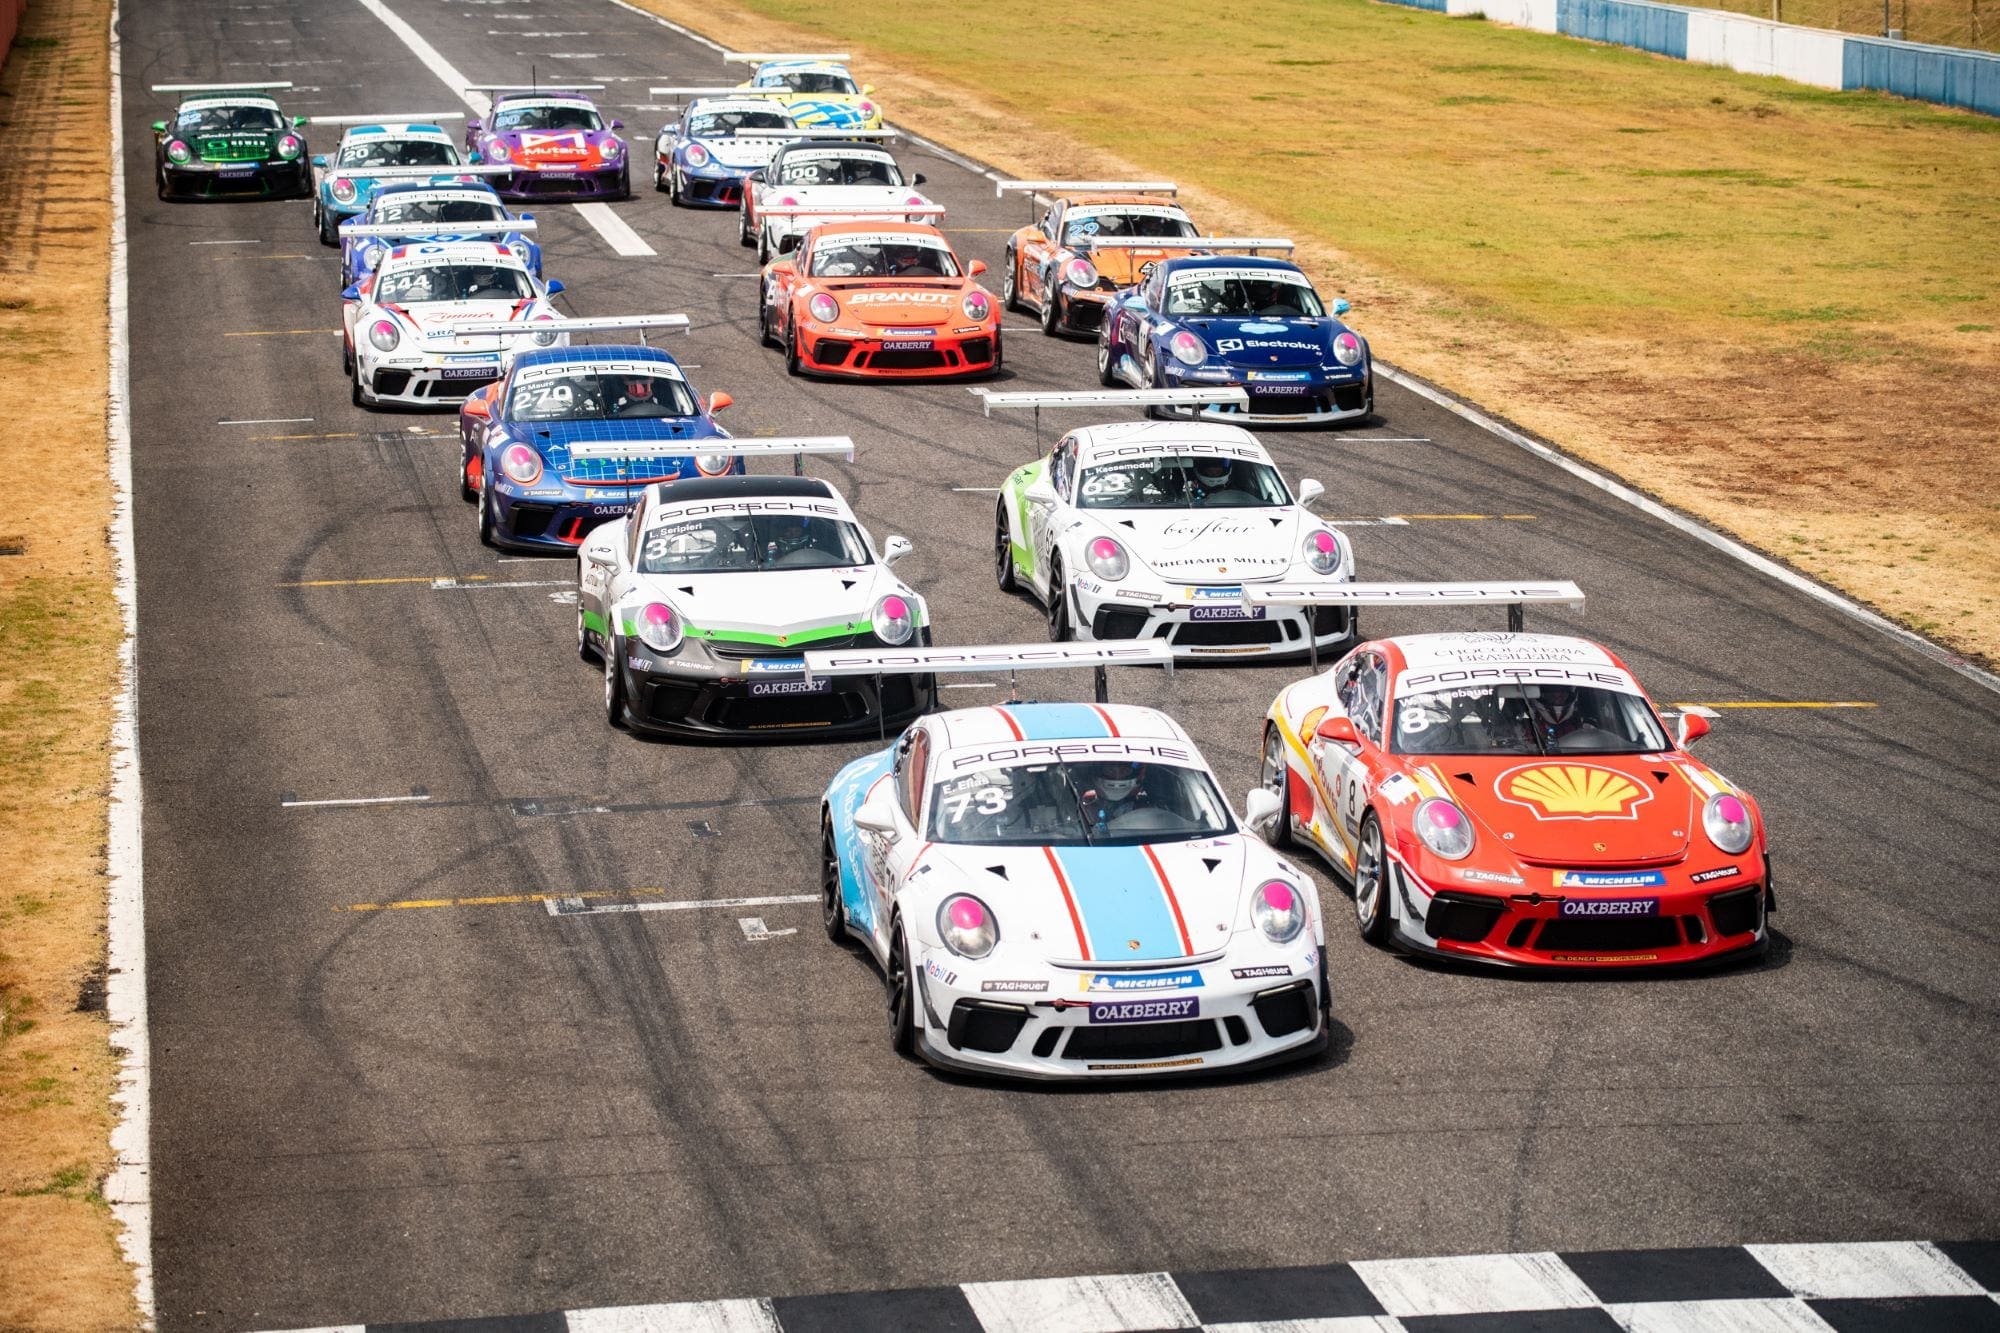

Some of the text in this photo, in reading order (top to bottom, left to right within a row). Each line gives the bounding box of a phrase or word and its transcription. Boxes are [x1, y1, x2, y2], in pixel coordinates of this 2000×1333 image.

[343, 148, 370, 163] 20
[524, 147, 589, 155] Mutant
[782, 166, 818, 181] 100
[374, 206, 402, 223] 12
[1068, 222, 1100, 238] 29
[820, 235, 941, 247] PORSCHE
[391, 256, 517, 270] PORSCHE
[1175, 270, 1301, 284] PORSCHE
[380, 273, 433, 296] 544
[846, 292, 960, 305] BRANDT
[883, 341, 932, 350] OAKBERRY
[1246, 339, 1321, 351] Electrolux
[444, 368, 495, 378] OAKBERRY
[523, 364, 673, 380] PORSCHE
[527, 381, 554, 391] Mauro
[1254, 385, 1306, 395] OAKBERRY
[512, 384, 574, 410] 270
[1093, 445, 1260, 461] PORSCHE
[1085, 468, 1095, 477] L.
[1081, 472, 1135, 496] 63
[659, 502, 840, 521] PORSCHE
[645, 534, 689, 561] 31
[1159, 557, 1280, 568] RICHARD MILLE
[1265, 589, 1562, 598] PORSCHE
[1193, 606, 1262, 619] OAKBERY
[830, 648, 1152, 667] PORSCHE
[1434, 645, 1587, 657] CHOCOLATERIA
[1458, 651, 1572, 663] BRASILEIRA
[1406, 668, 1624, 688] PORSCHE
[1399, 707, 1429, 734] 8
[952, 744, 1190, 770] PORSCHE
[942, 784, 956, 795] E.
[943, 786, 1008, 825] 73
[1583, 875, 1657, 885] MICHELIN
[1563, 901, 1654, 915] OAKBERRY
[925, 958, 947, 980] Mobil
[1114, 975, 1193, 989] MICHELIN
[1095, 1001, 1194, 1020] OAKBERRY
